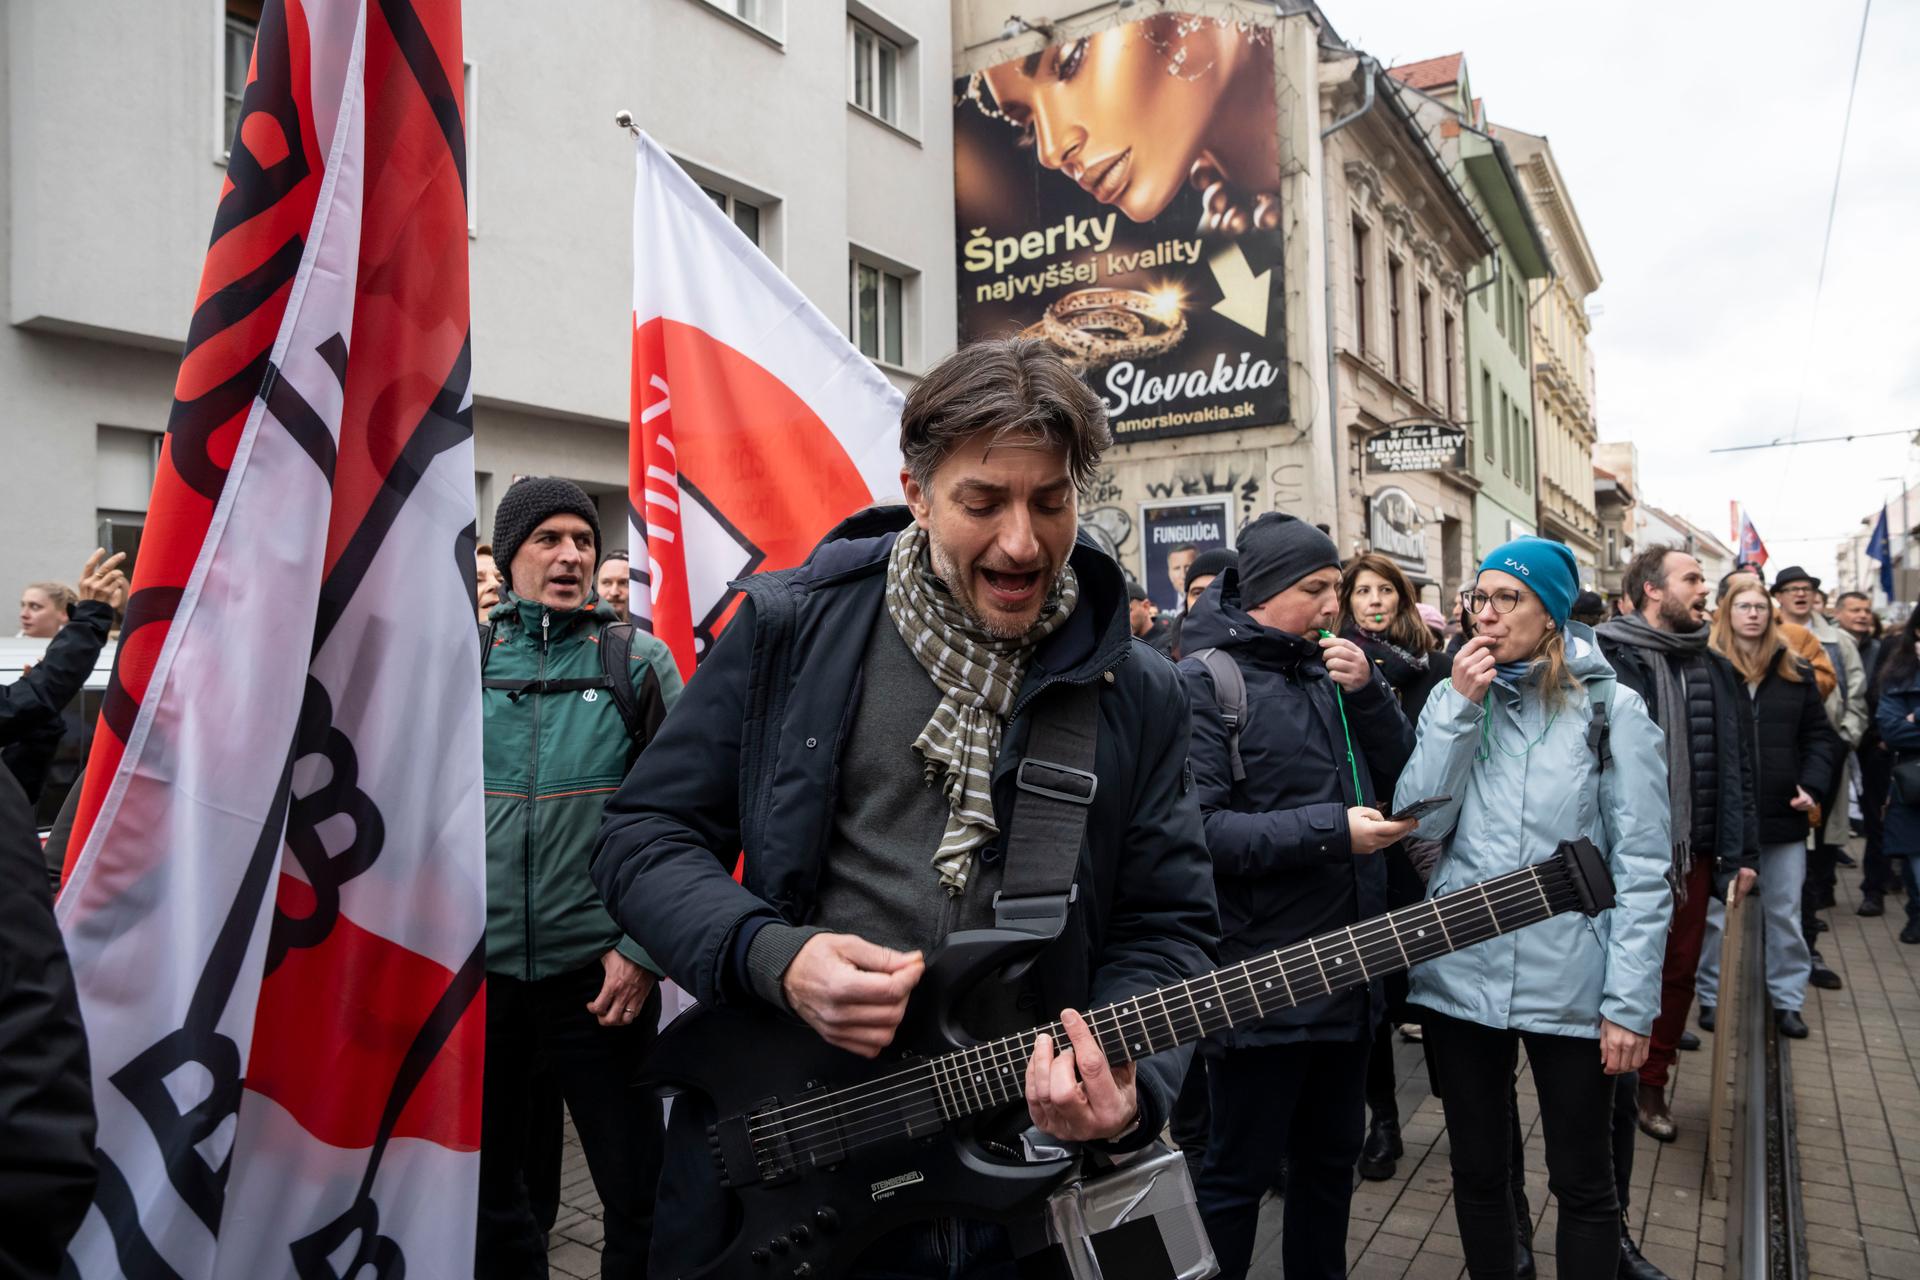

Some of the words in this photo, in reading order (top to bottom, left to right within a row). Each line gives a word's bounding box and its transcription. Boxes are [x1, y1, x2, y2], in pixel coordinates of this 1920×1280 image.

[964, 213, 1117, 273] Šperky
[976, 259, 1098, 303] najvyššej
[1107, 239, 1202, 275] kvality
[1101, 352, 1279, 417] Slovakia
[1115, 401, 1256, 433] amorslovakia.sk
[1367, 434, 1465, 453] JEWELLERY
[1153, 521, 1219, 544] FUNGUJÚCA
